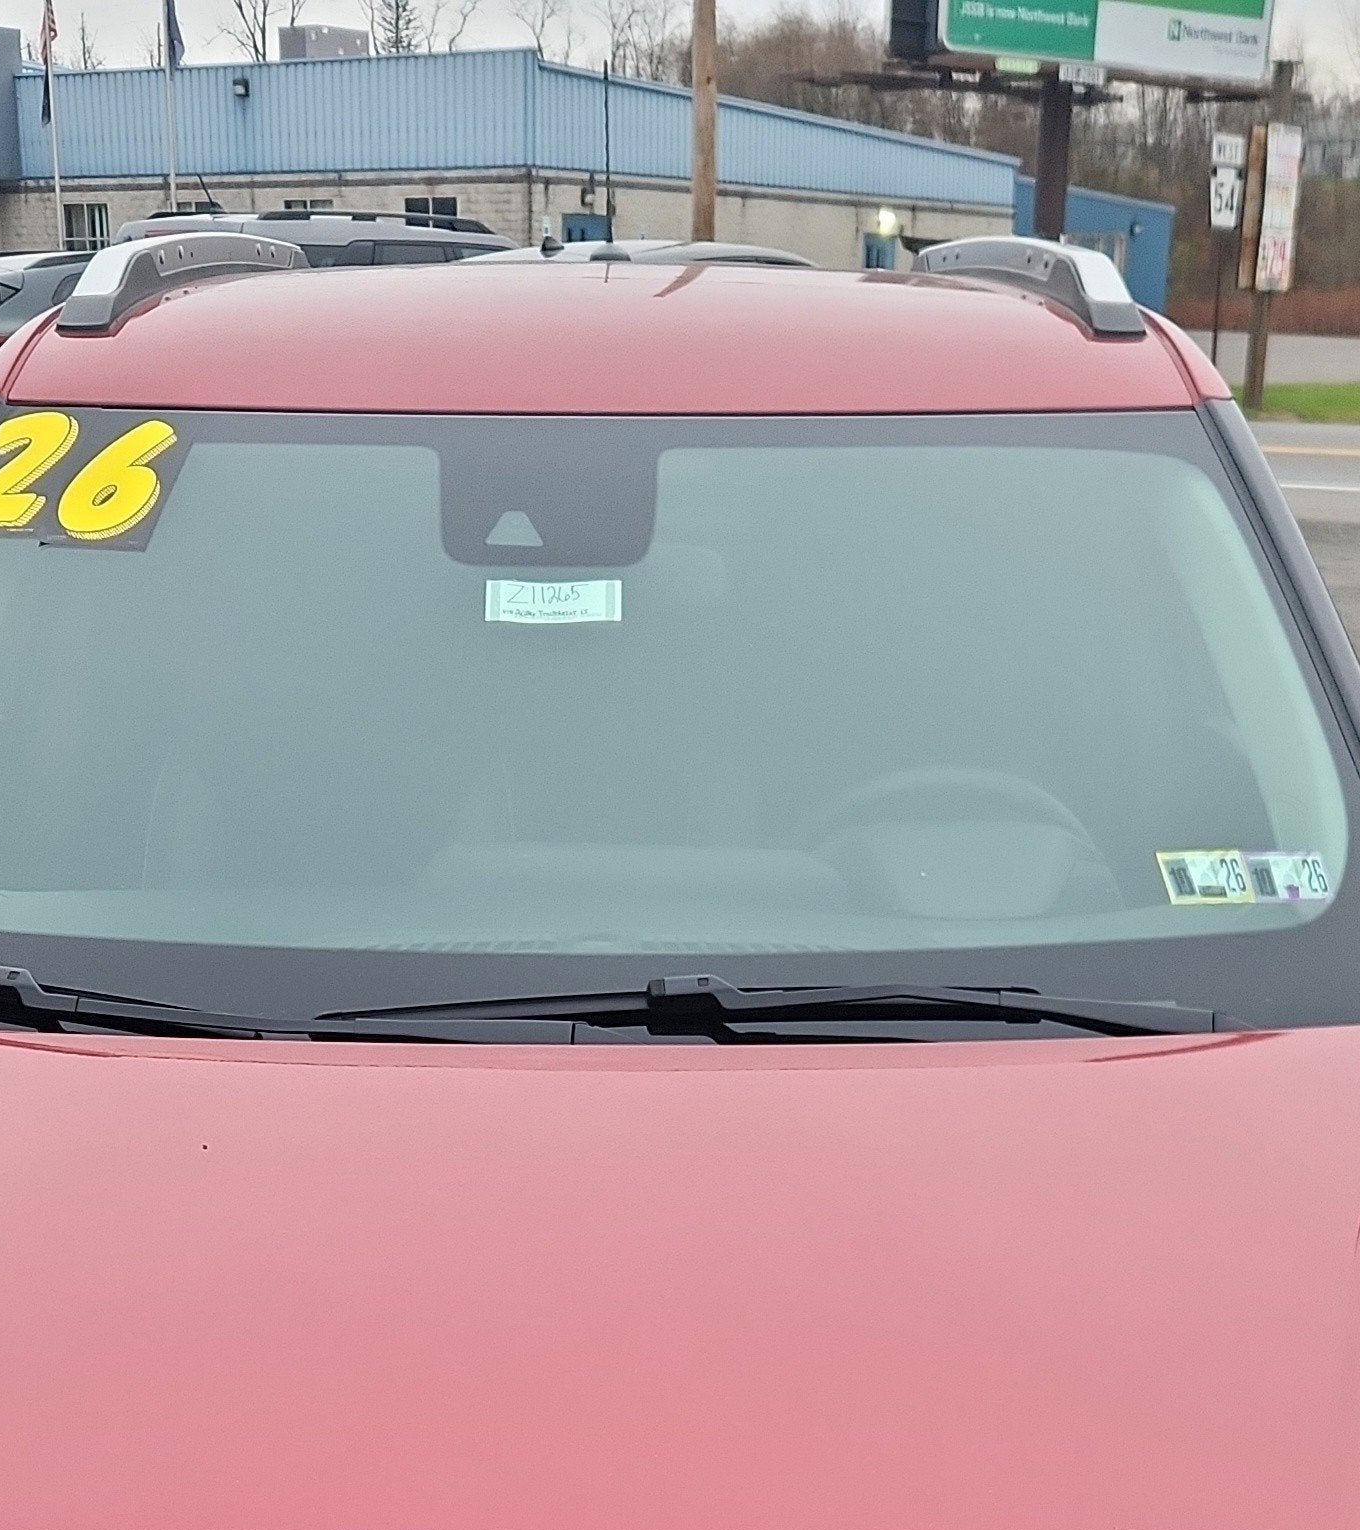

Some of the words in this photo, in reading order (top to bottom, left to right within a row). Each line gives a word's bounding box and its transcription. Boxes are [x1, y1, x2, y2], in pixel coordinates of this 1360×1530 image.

[1018, 6, 1065, 25] Northwest
[1066, 11, 1090, 27] Bank
[1183, 23, 1232, 44] Northwest
[1235, 30, 1259, 45] Bank
[1214, 183, 1235, 213] 54
[1220, 858, 1247, 893] 26
[1301, 858, 1329, 893] 26
